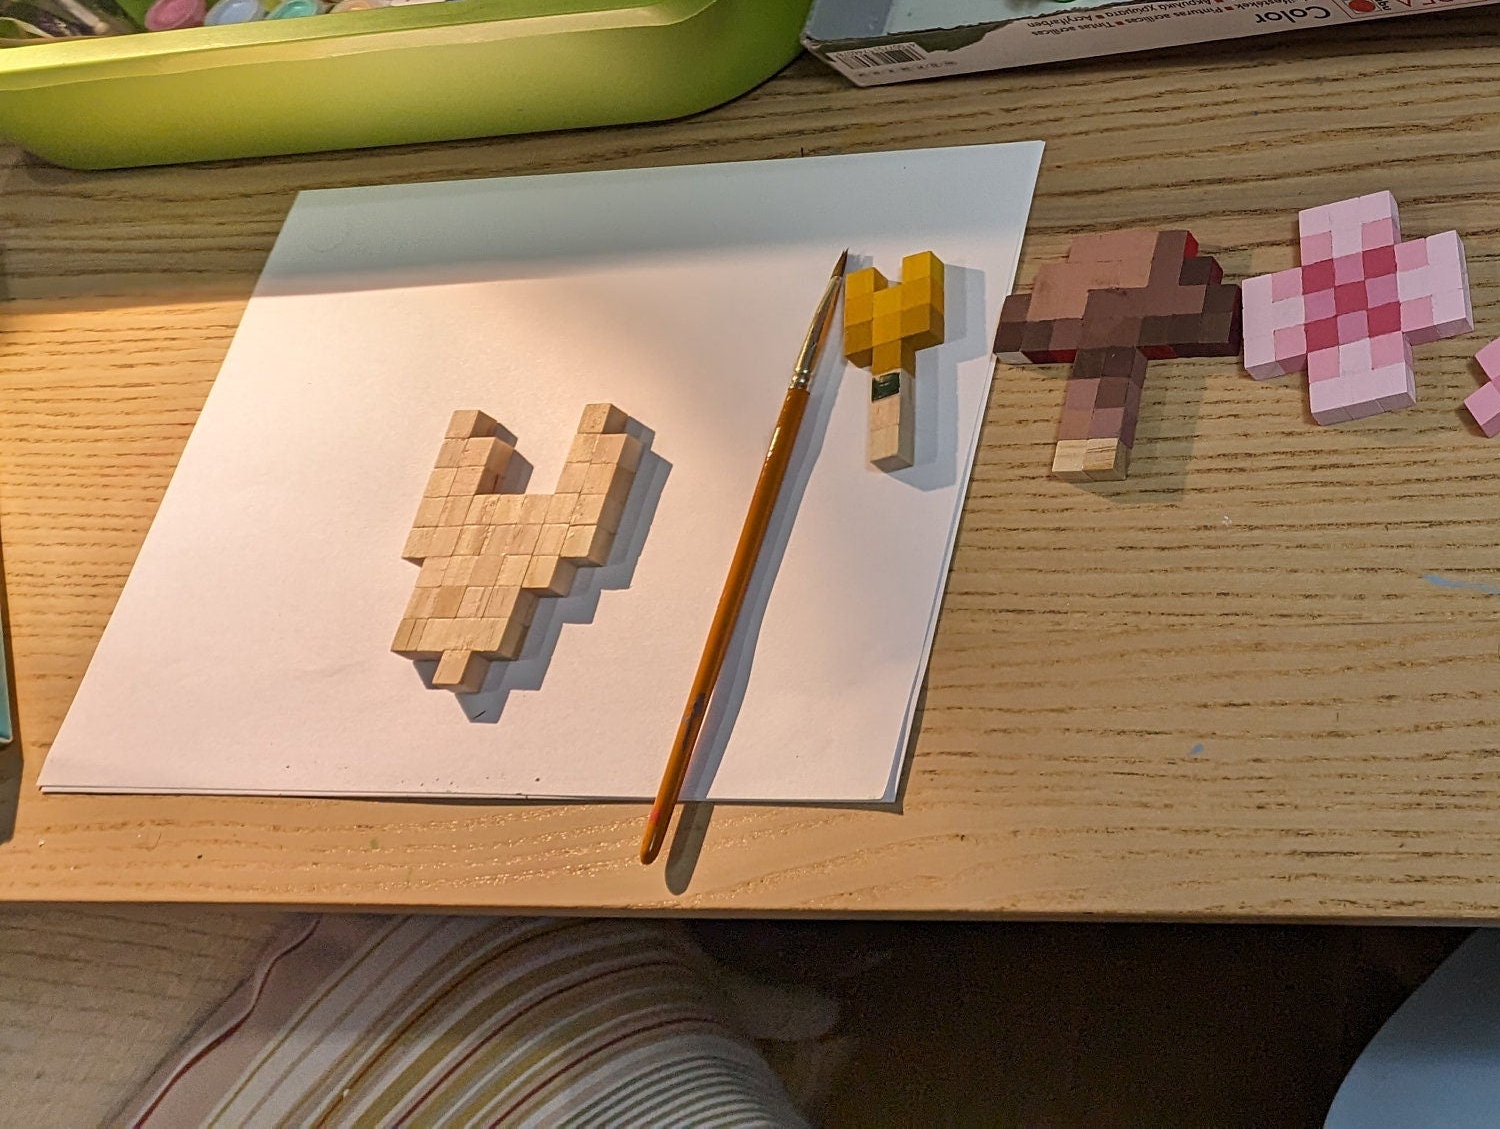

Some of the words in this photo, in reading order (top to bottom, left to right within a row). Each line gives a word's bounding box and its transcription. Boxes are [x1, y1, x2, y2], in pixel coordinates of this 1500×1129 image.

[1173, 5, 1224, 18] Pinturas
[1255, 5, 1332, 24] Color
[1026, 13, 1092, 28] Acrylfarben
[1078, 20, 1117, 31] Tintas
